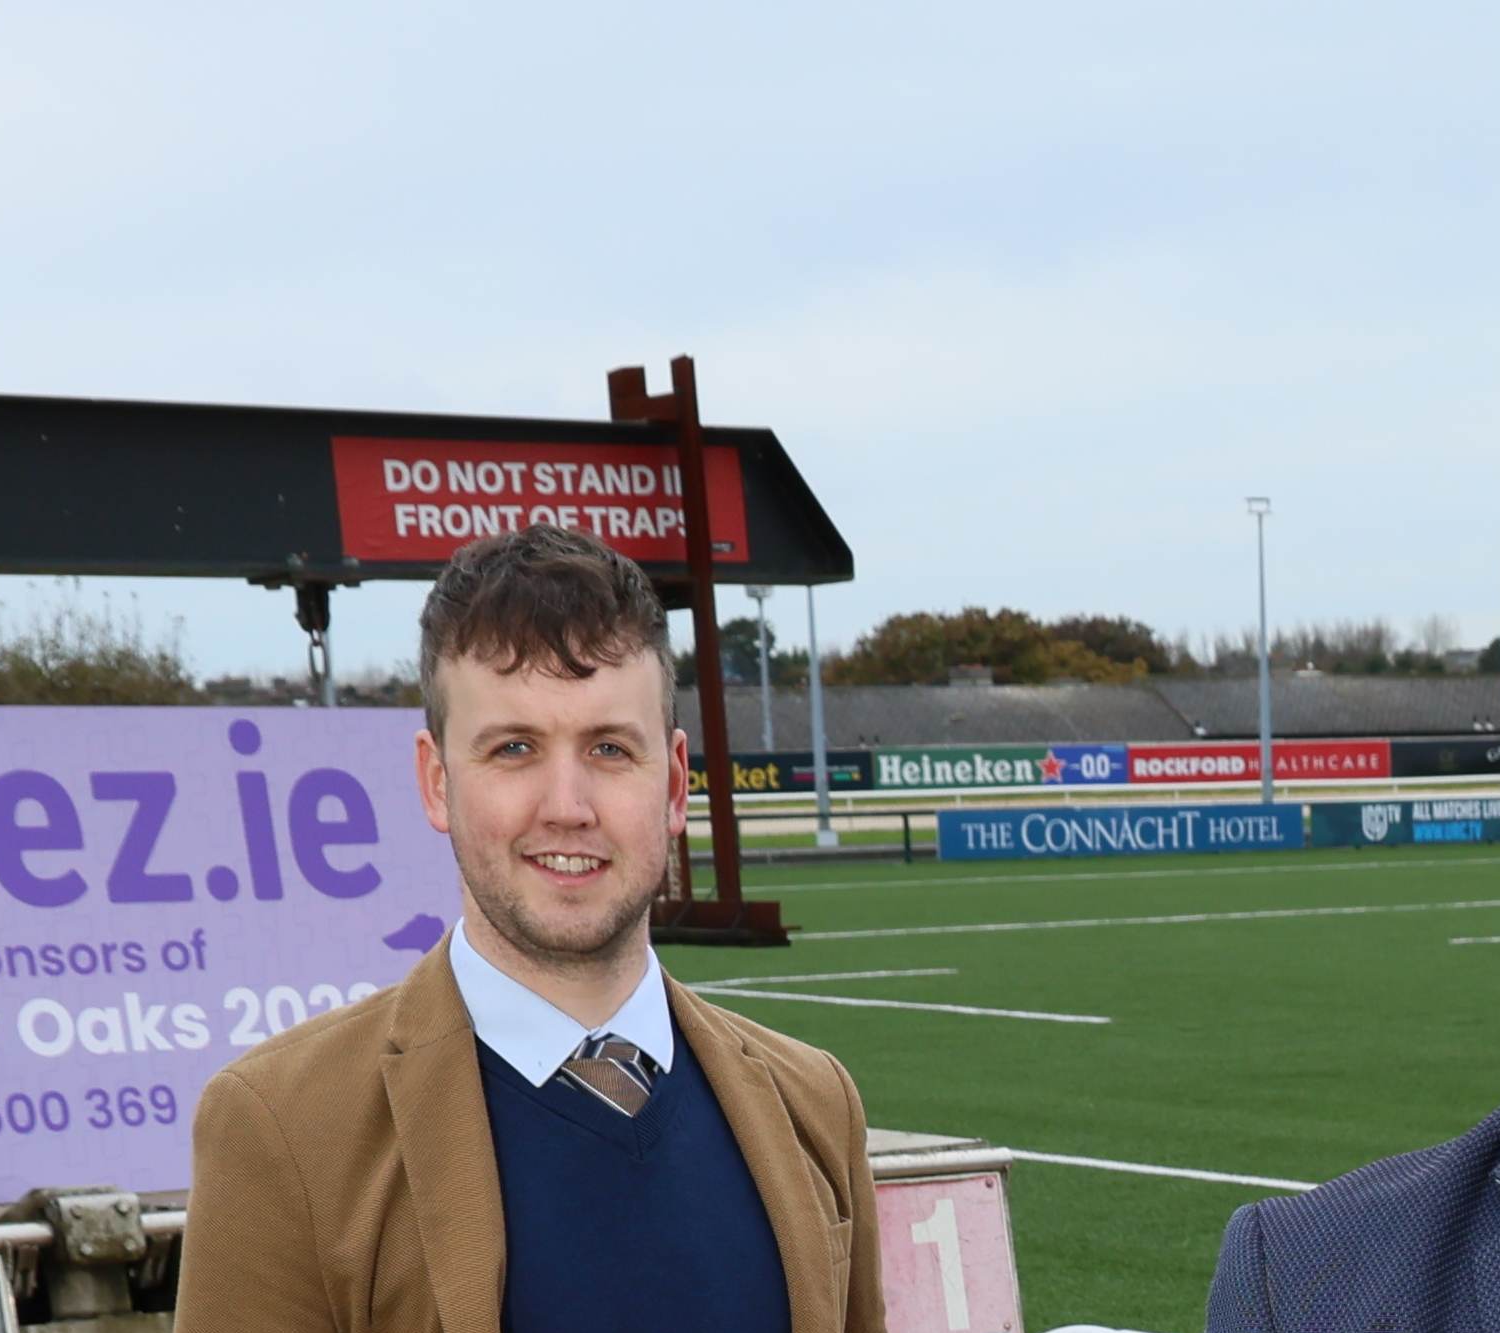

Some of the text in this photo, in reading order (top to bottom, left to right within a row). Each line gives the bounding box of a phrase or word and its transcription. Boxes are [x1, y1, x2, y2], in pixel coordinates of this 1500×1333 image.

[383, 458, 440, 493] DO
[447, 460, 526, 494] NOT
[533, 463, 656, 496] STAND
[394, 503, 522, 537] FRONT
[877, 755, 1035, 785] Heineken
[1133, 753, 1380, 777] ROCKFORD HALTHCARE
[1432, 800, 1480, 820] MATCHES
[962, 822, 1013, 850] THE
[1208, 815, 1284, 843] HOTEL
[161, 928, 208, 972] of
[17, 990, 211, 1058] Oaks
[223, 982, 390, 1046] 20
[86, 1085, 178, 1134] 369
[911, 1198, 970, 1331] 1
